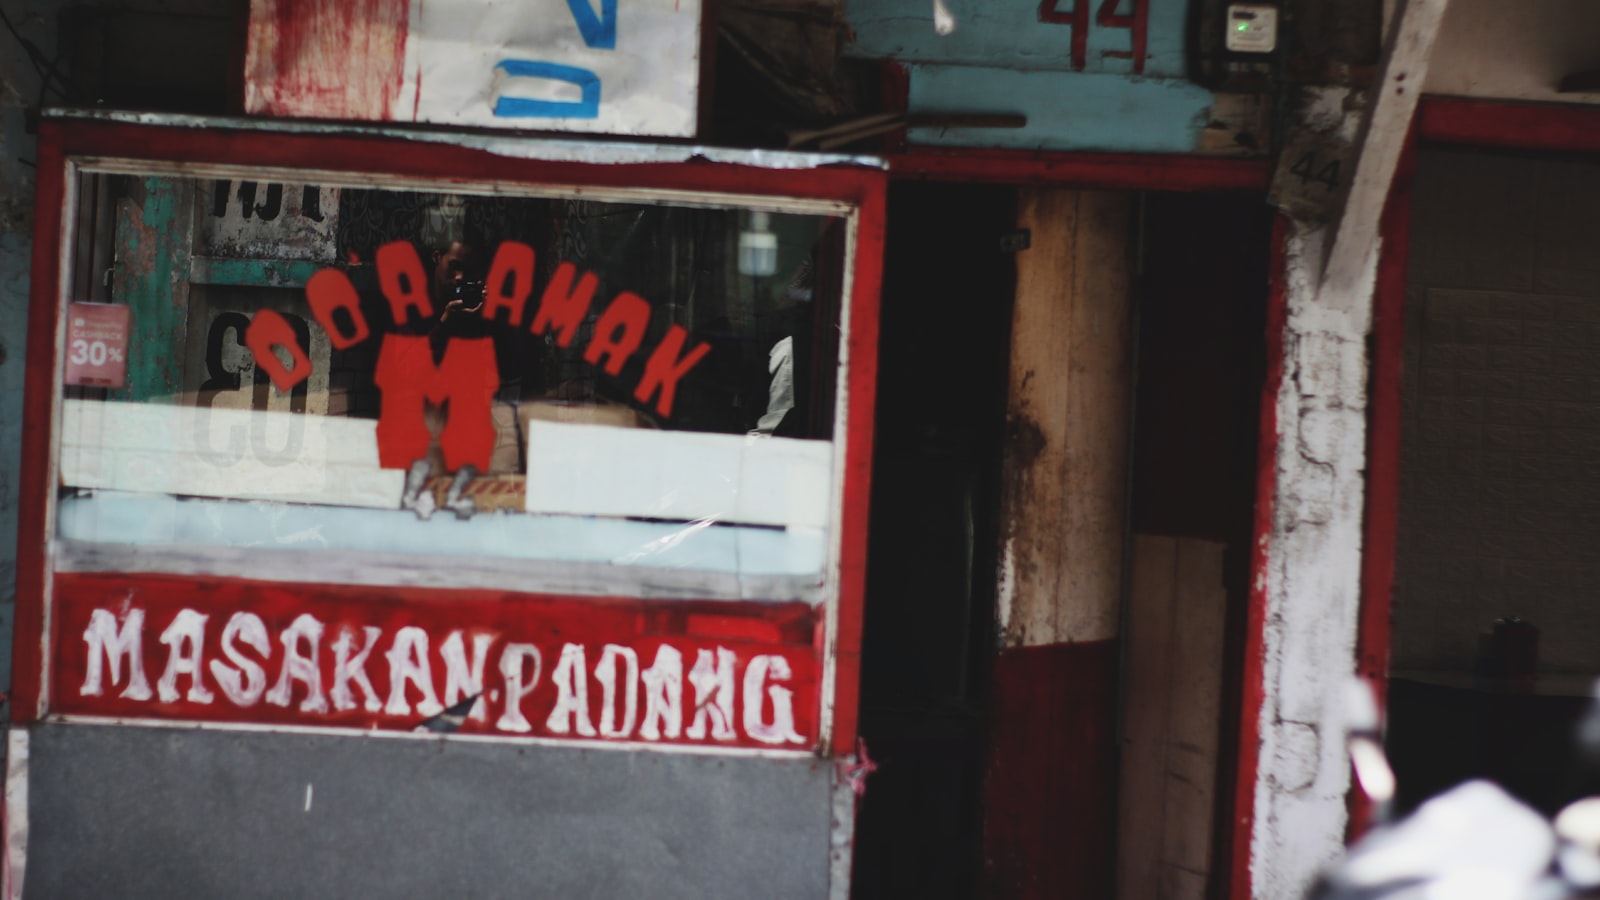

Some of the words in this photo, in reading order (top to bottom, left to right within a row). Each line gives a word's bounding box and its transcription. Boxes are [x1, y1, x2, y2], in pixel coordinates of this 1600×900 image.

[1289, 151, 1341, 193] 44
[482, 240, 712, 419] AMAK
[70, 339, 123, 366] 30%
